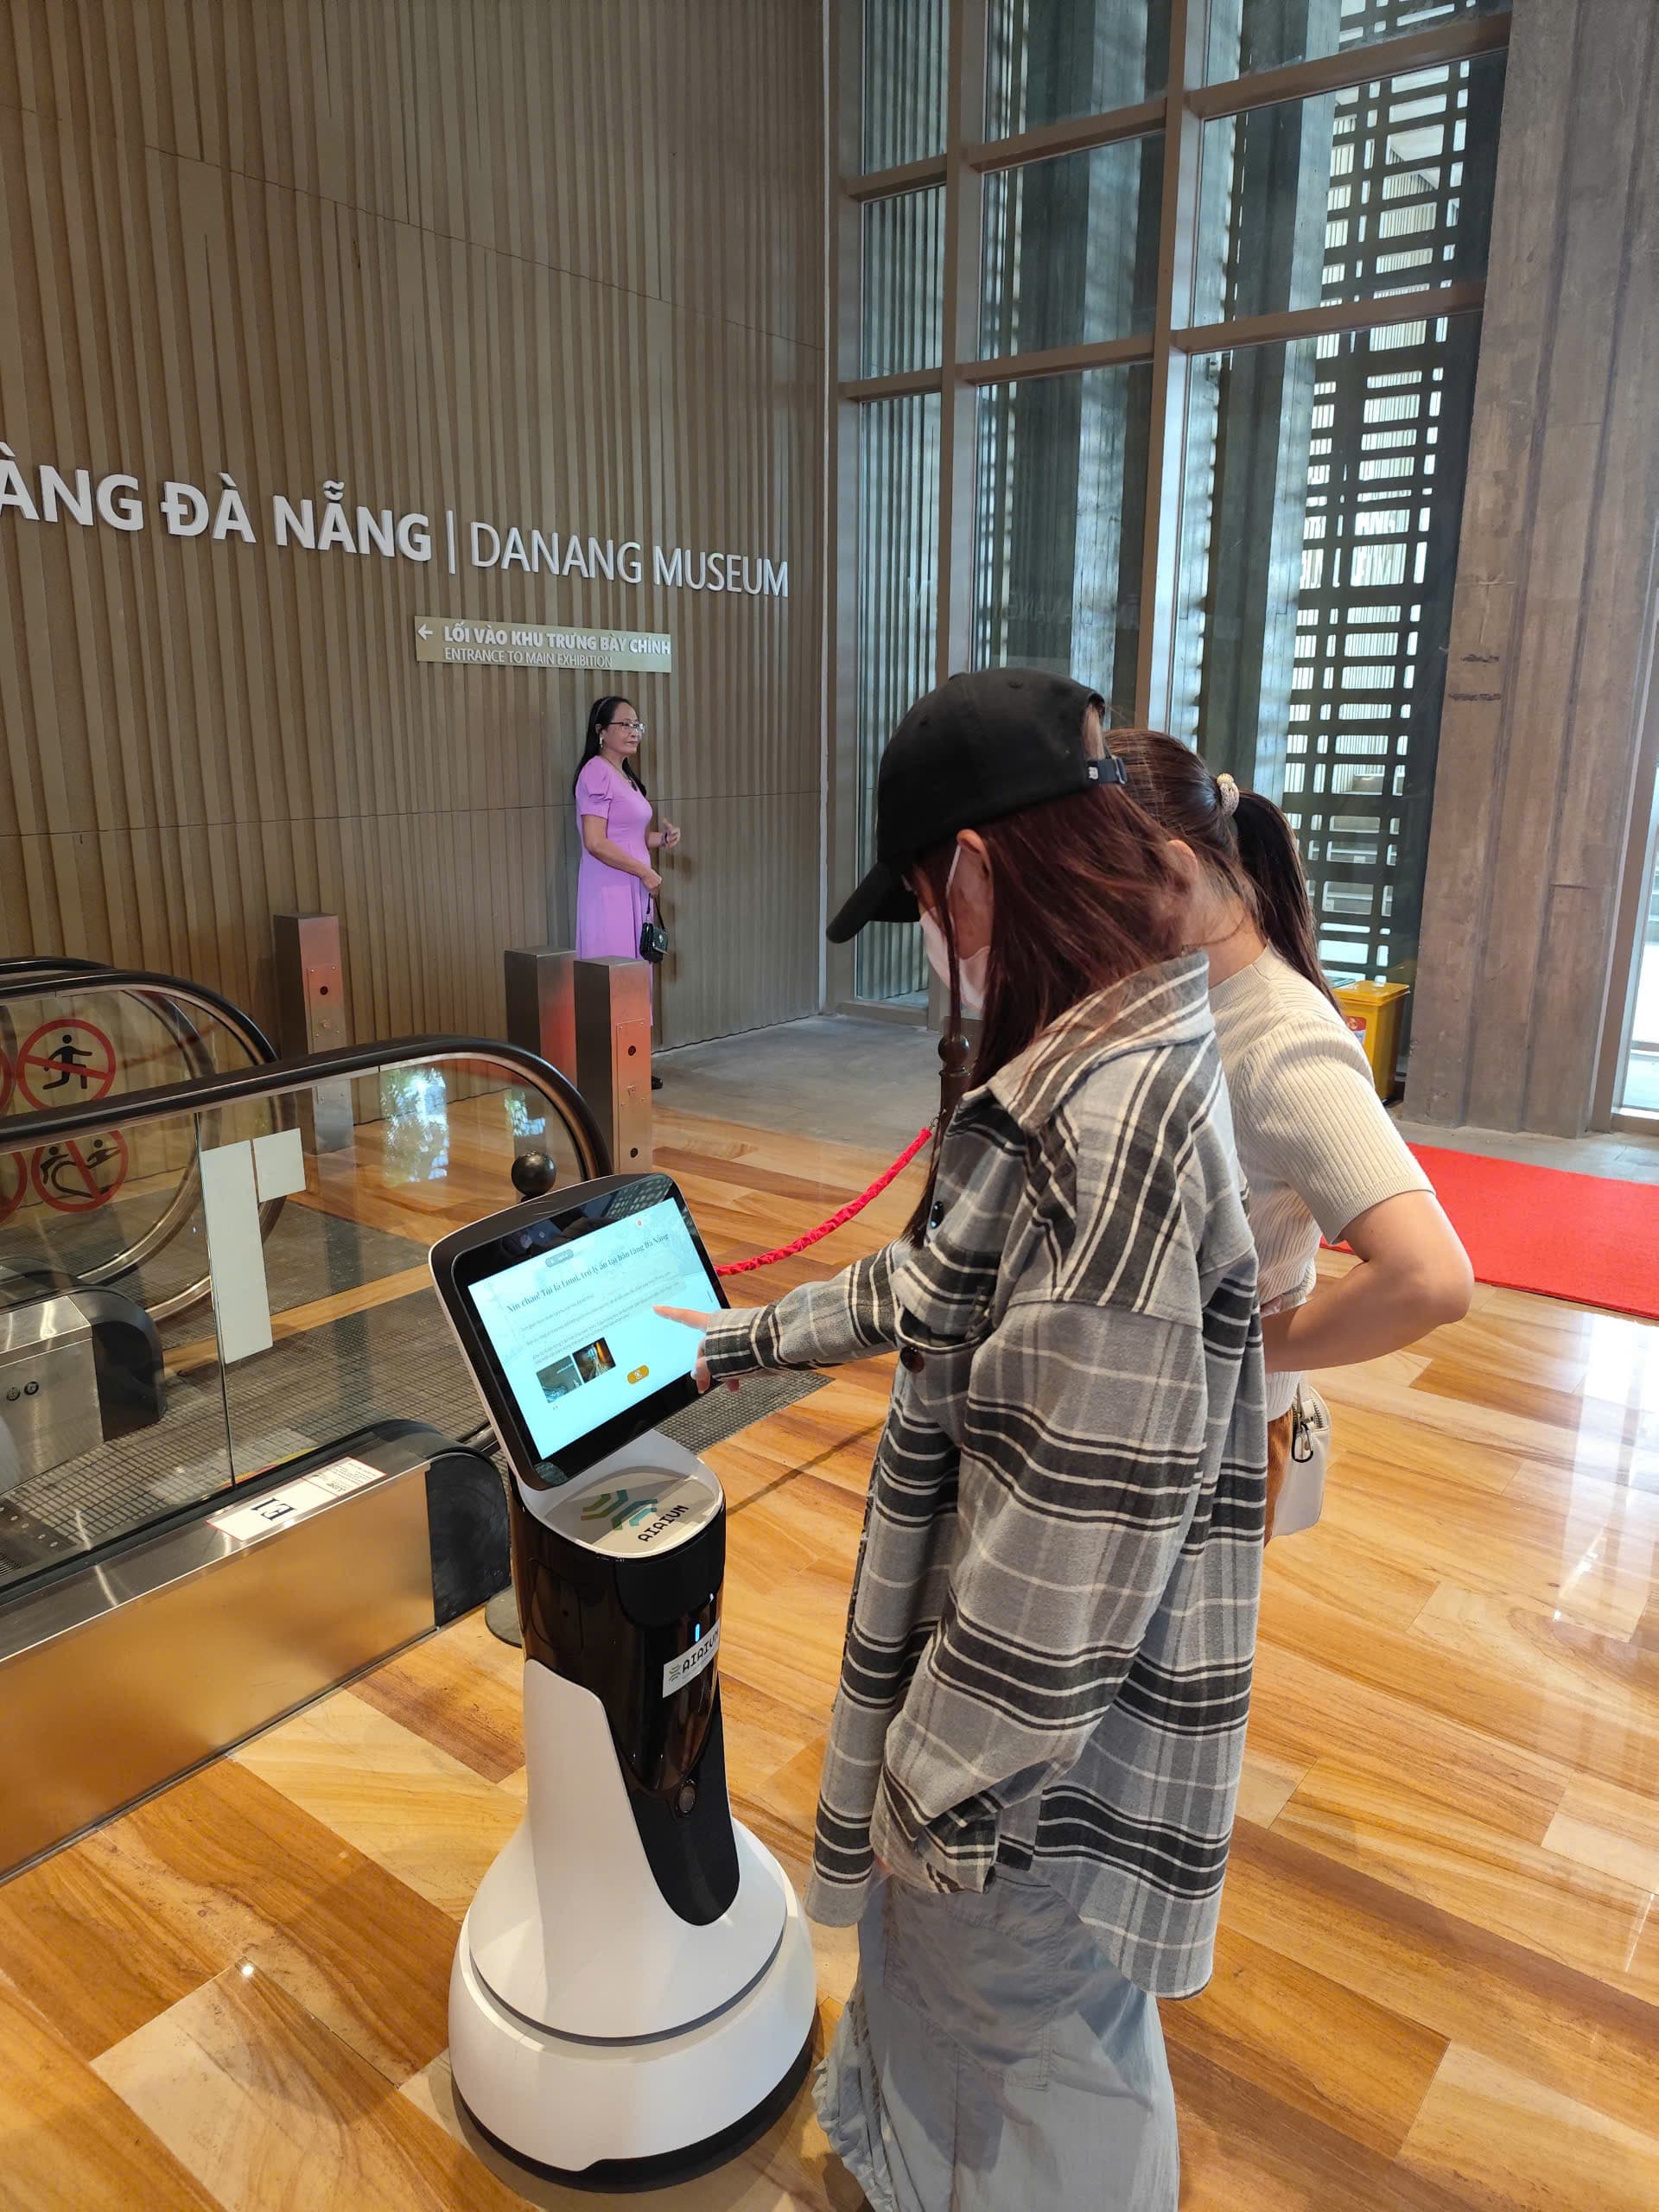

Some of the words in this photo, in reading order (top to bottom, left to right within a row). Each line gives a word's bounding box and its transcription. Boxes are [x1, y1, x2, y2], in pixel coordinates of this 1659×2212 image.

[160, 472, 257, 543] ĐÀ
[273, 480, 432, 562] NẴNG
[470, 521, 642, 584] DANANG
[652, 545, 789, 598] MUSEUM
[444, 621, 470, 644] LỐI
[474, 625, 508, 646] VÀO
[511, 631, 543, 648] KHU
[546, 632, 597, 651] TRƯNG
[600, 632, 627, 652] BÀY
[629, 637, 671, 655] CHÍNH
[445, 647, 505, 664] ENTRANCE
[507, 651, 523, 664] TO
[525, 652, 555, 666] MAIN
[557, 653, 613, 668] EXHIBITION
